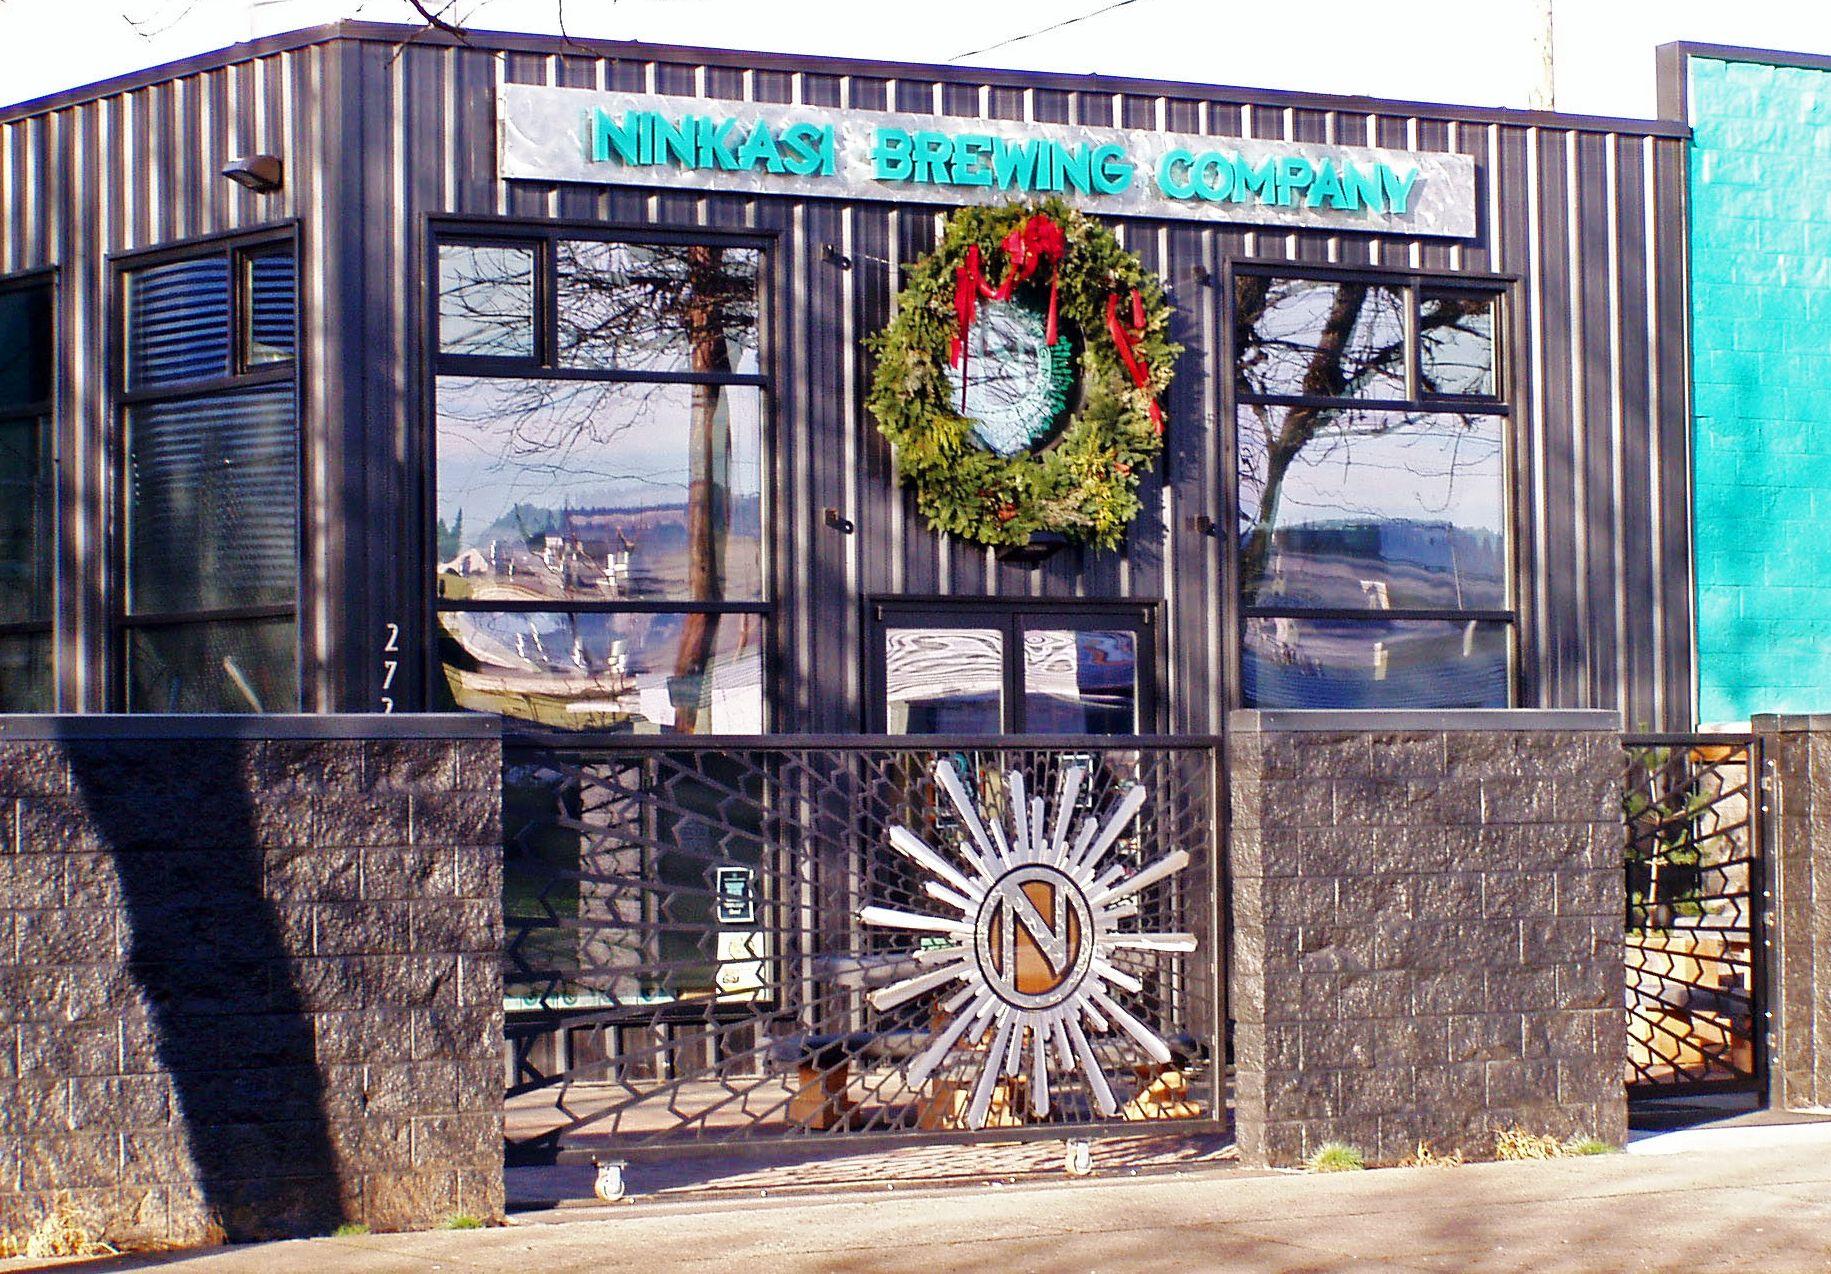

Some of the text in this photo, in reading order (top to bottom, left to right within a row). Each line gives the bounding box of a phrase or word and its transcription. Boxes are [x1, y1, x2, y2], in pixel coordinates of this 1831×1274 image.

[592, 106, 1418, 214] NINKASI BREWING COMPANY
[1000, 880, 1067, 996] N
